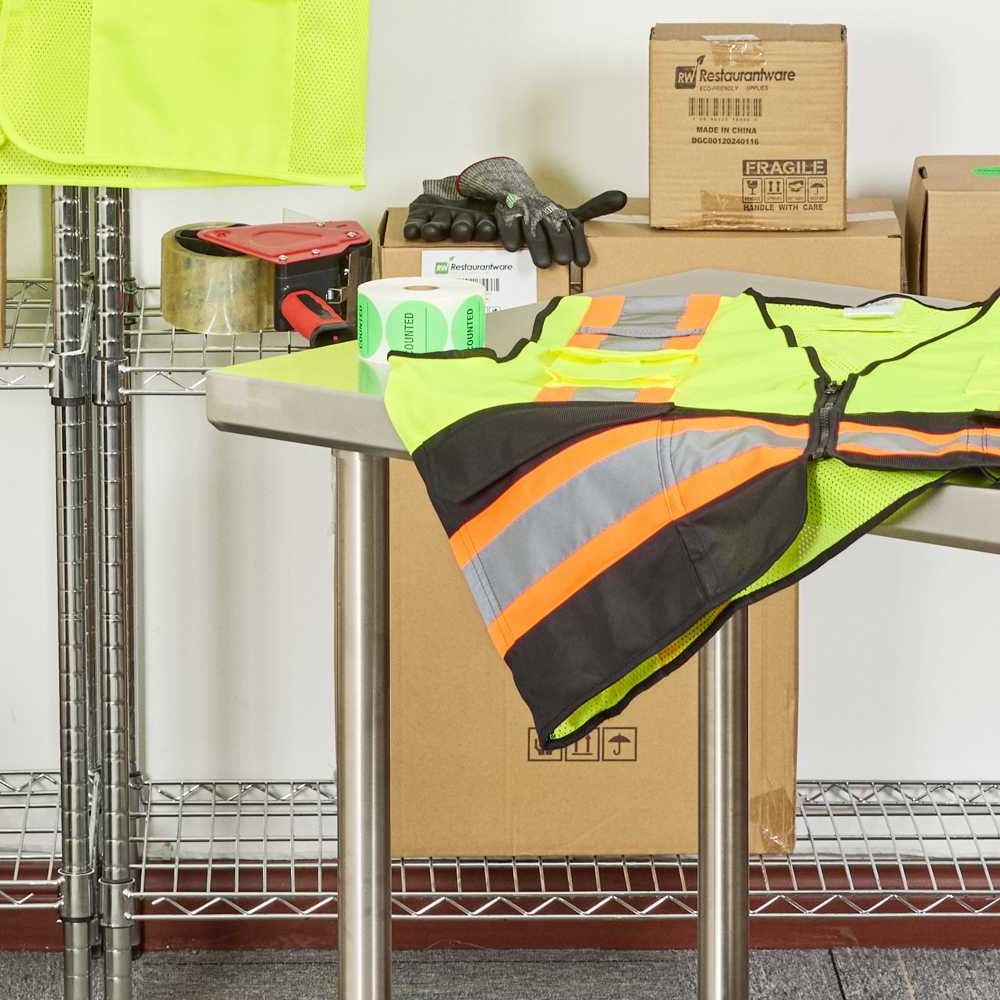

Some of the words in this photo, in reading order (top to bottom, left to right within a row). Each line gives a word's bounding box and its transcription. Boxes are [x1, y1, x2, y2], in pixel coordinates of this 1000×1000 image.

[678, 71, 695, 83] RW
[699, 68, 796, 82] Restaurantware
[745, 160, 825, 175] FRAGILE
[803, 203, 824, 211] CARE
[450, 263, 513, 271] Restaurantware
